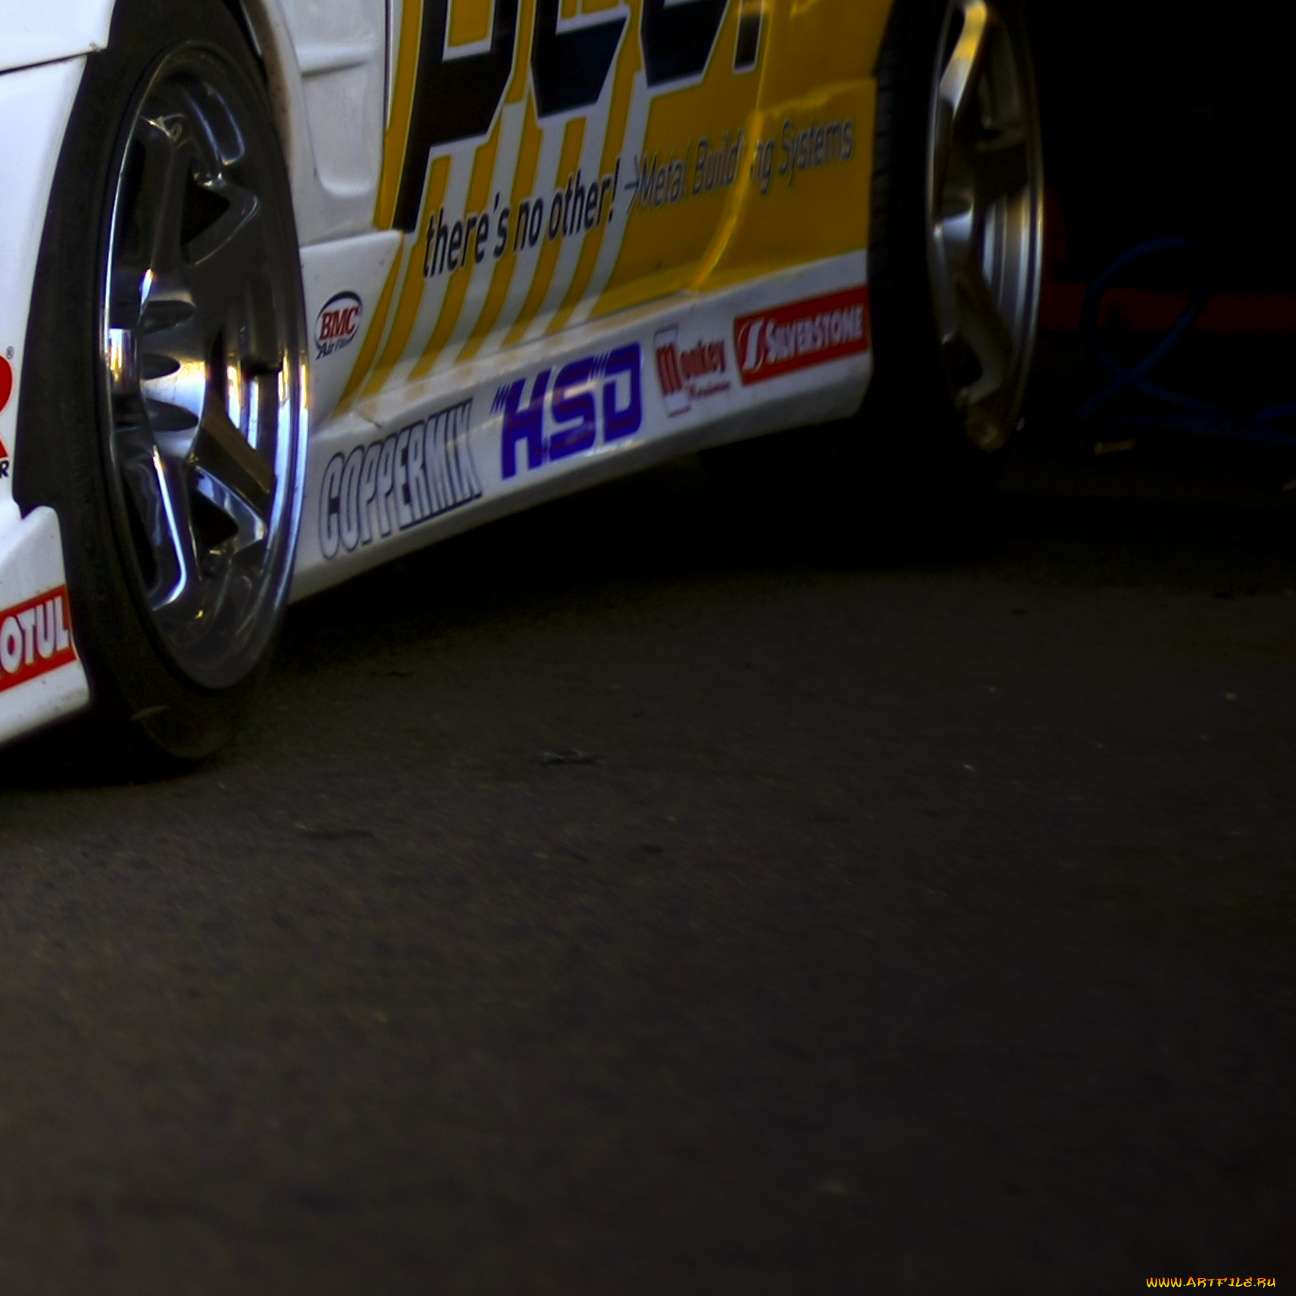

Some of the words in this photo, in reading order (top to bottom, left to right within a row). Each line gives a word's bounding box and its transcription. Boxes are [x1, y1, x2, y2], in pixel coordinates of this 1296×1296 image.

[422, 190, 512, 278] there's
[512, 196, 544, 253] no
[548, 156, 622, 243] other!
[778, 117, 854, 191] Systems
[319, 306, 361, 342] BMC
[765, 308, 865, 365] SILVERSTONE
[320, 398, 483, 561] COPPERMIX
[491, 343, 644, 481] HSD
